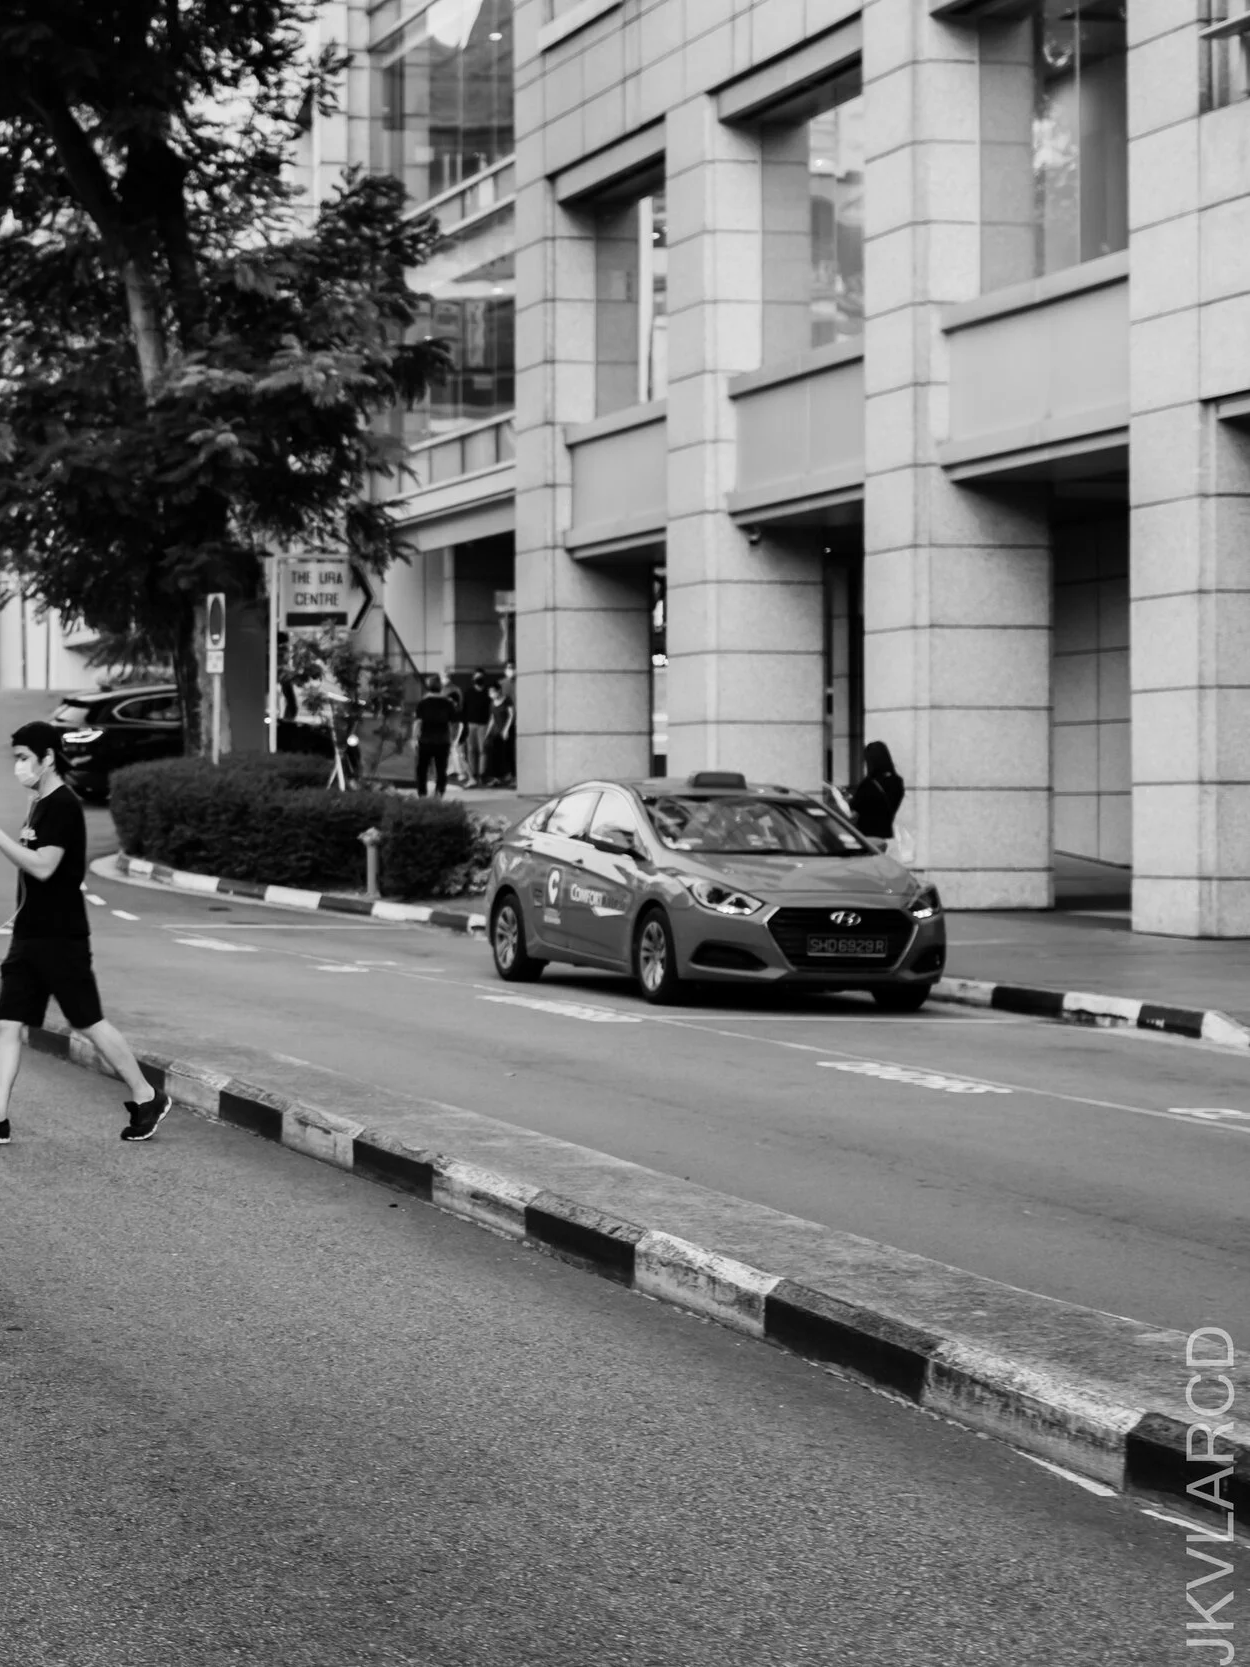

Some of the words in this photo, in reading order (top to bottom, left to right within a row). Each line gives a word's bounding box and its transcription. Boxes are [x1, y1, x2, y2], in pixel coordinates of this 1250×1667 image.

[291, 571, 310, 584] THE
[319, 571, 344, 584] URA
[295, 593, 339, 606] CENTRE
